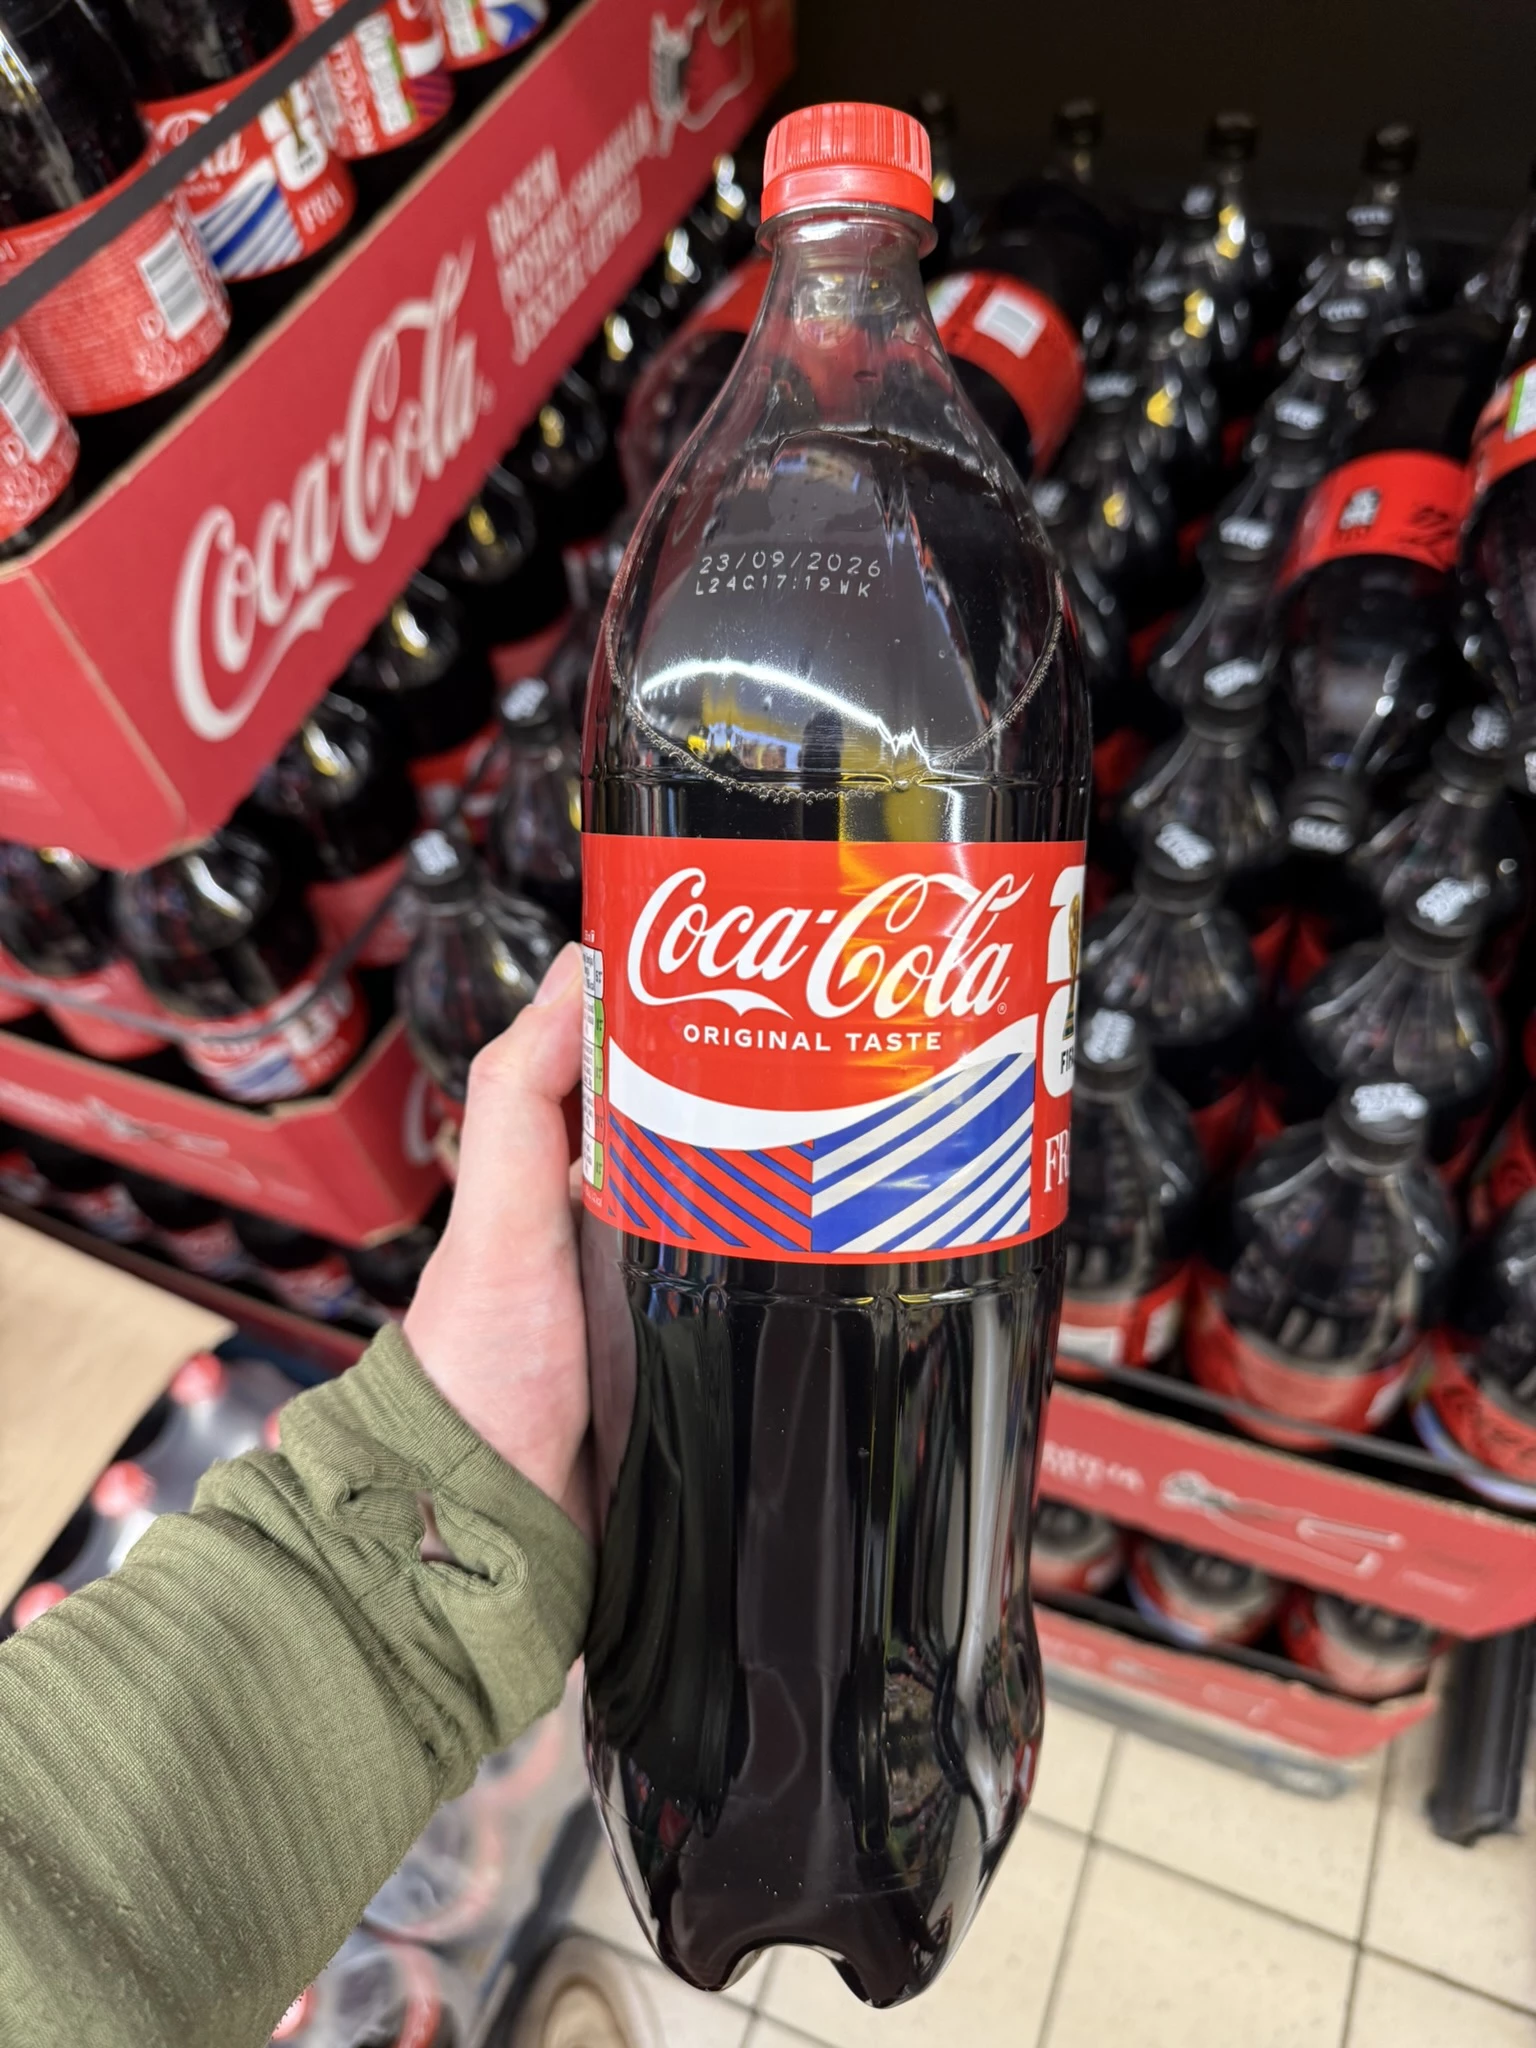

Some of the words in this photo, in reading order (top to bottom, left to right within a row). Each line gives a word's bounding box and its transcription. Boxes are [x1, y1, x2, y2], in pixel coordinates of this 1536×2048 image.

[170, 235, 478, 743] Coca-Cola
[699, 550, 882, 578] 23/09/2026
[627, 866, 1035, 1019] Coca-Cola
[683, 1023, 832, 1052] ORIGINAL
[845, 1031, 943, 1052] TASTE
[1043, 1128, 1071, 1193] FR
